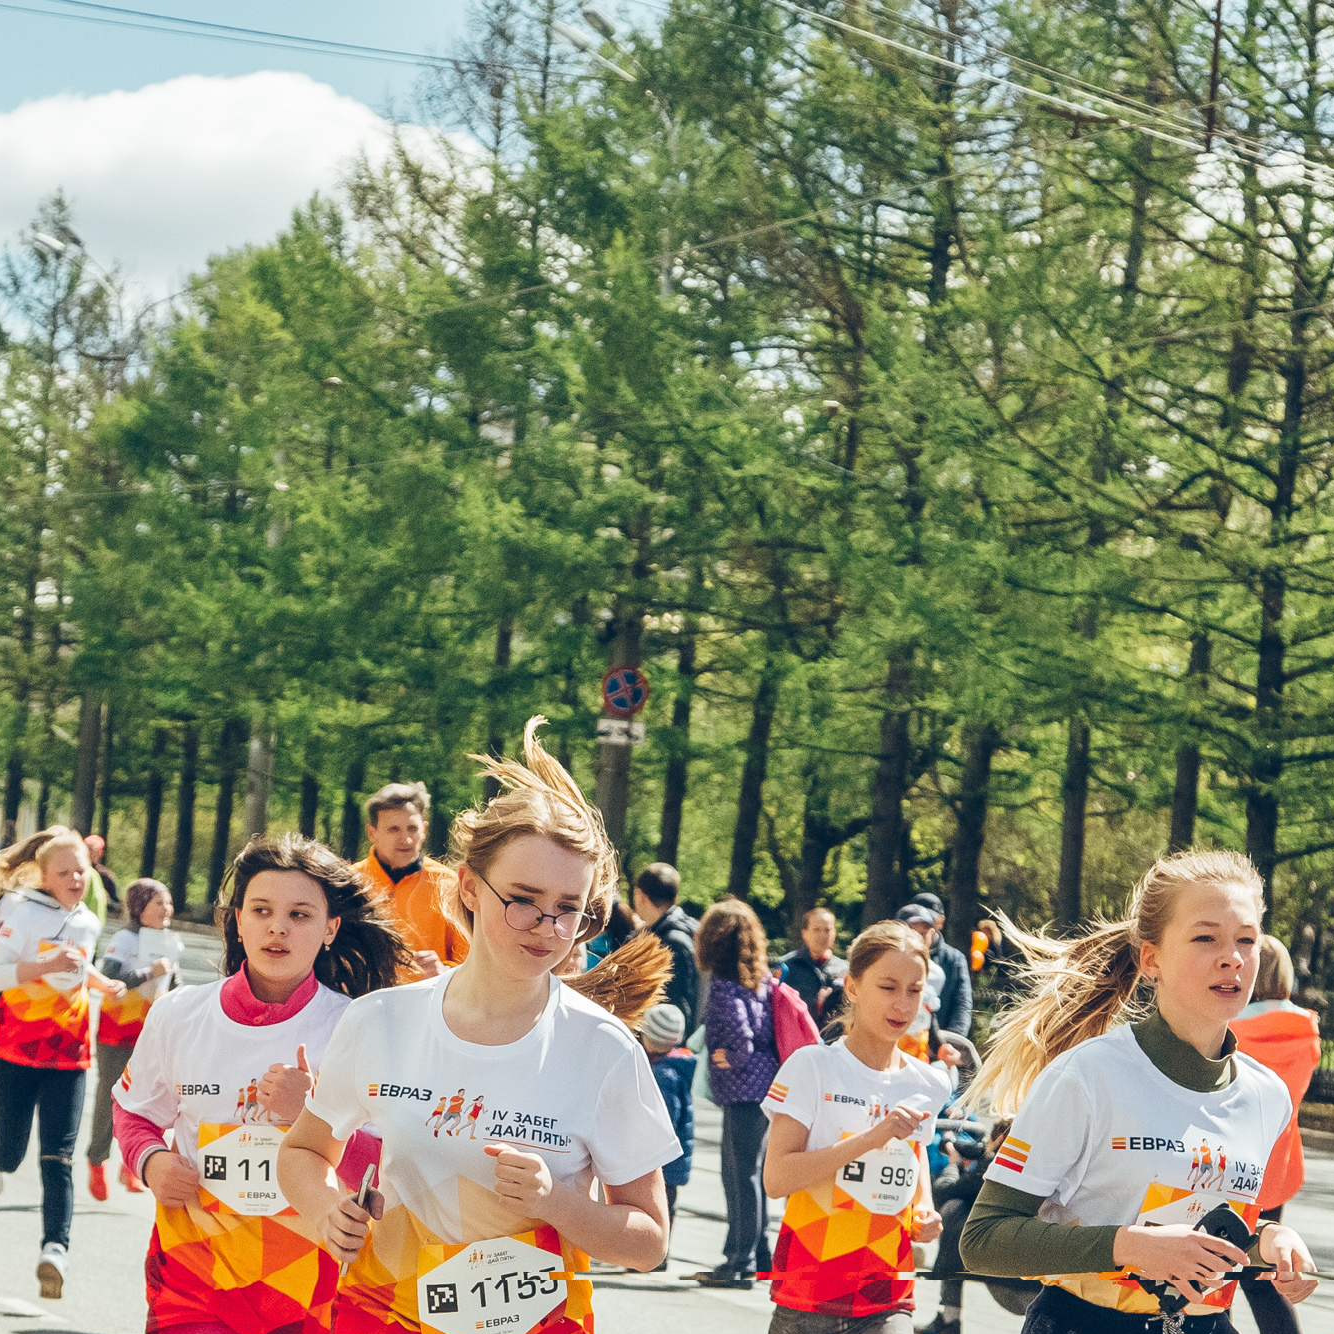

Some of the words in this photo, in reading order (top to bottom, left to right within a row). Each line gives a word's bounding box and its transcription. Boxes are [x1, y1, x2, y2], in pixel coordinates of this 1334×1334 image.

[181, 1084, 220, 1095] ЕВРАЗ
[380, 1083, 433, 1101] ЕВРАЗ
[834, 1094, 866, 1107] ЕВРАЗ
[492, 1110, 508, 1121] IV
[513, 1111, 558, 1130] ЗАБЕГ
[485, 1124, 527, 1139] «ДАЙ
[531, 1129, 572, 1147] ПЯТЬ!»
[1130, 1136, 1185, 1153] ЕВРАЗ
[1235, 1161, 1247, 1173] IV
[880, 1166, 914, 1187] 993
[493, 1250, 509, 1258] ЗАБЕГ
[485, 1314, 520, 1328] ЕВРАЗ
